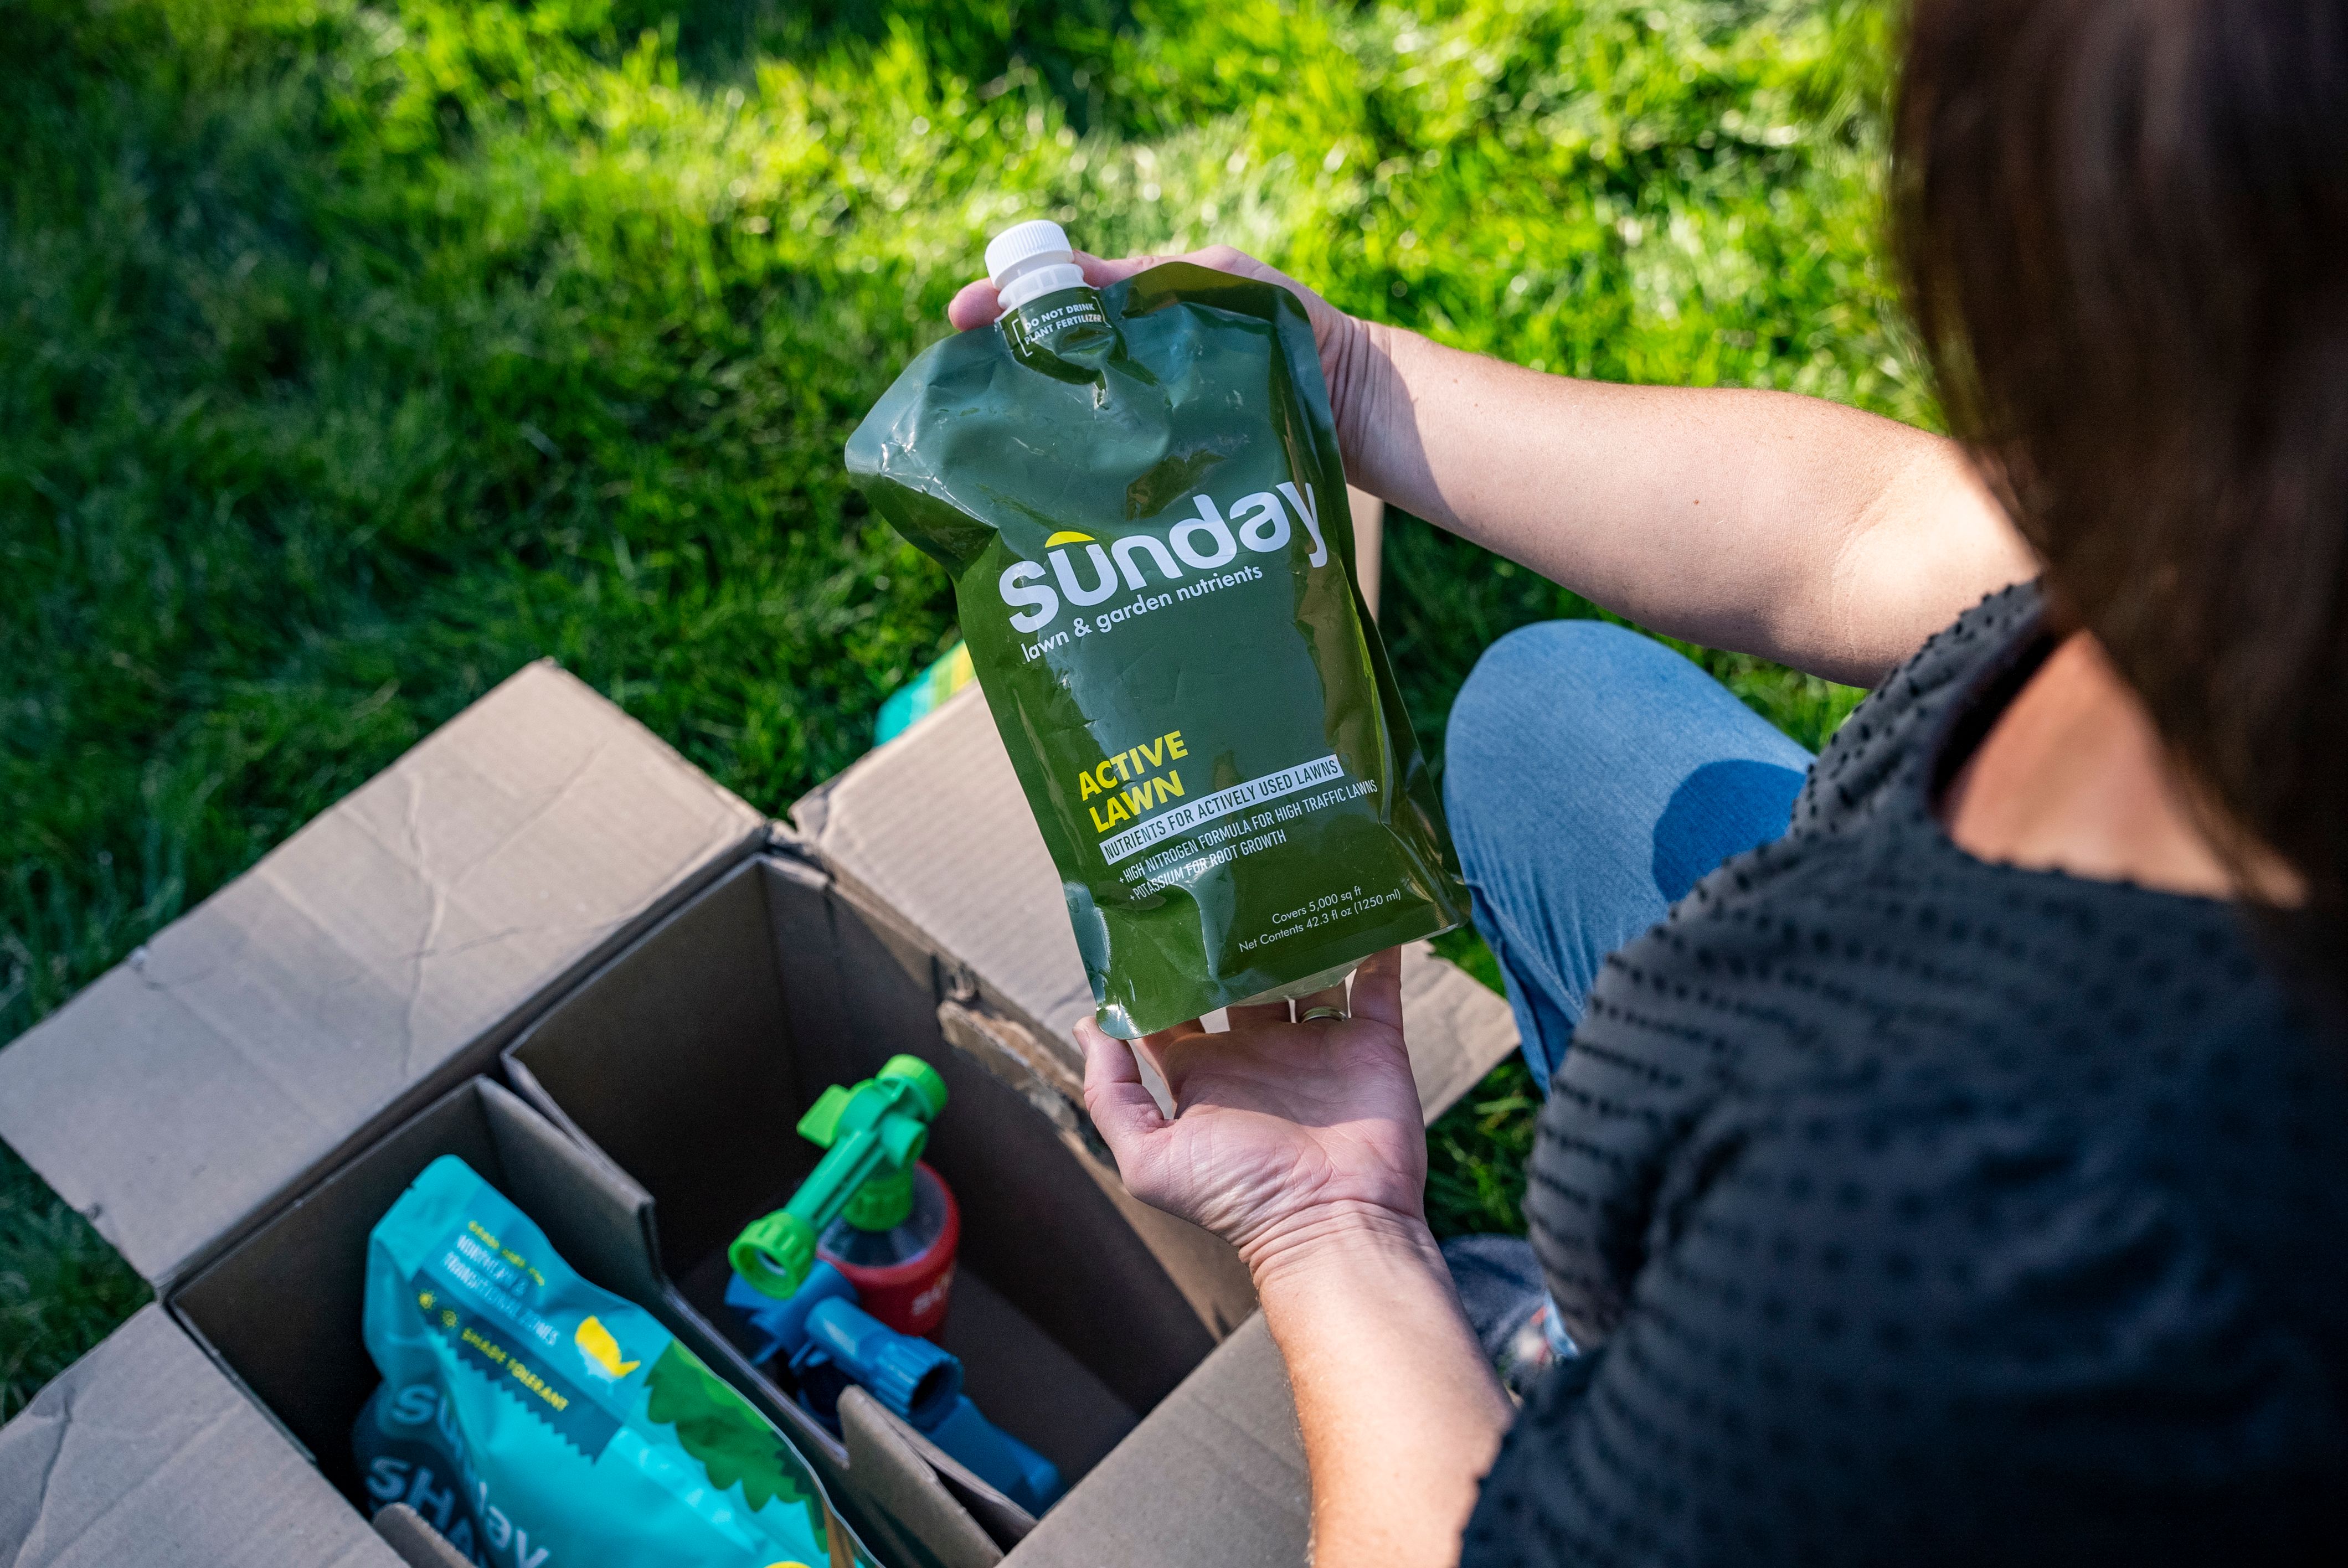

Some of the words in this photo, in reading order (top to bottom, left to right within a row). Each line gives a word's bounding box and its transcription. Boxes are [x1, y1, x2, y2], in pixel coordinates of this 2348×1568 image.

[1024, 318, 1039, 331] DO
[1041, 308, 1063, 322] NOT
[1065, 303, 1095, 314] DRINK
[1024, 324, 1053, 345] PLANT
[1055, 314, 1102, 329] FERTILIZER
[999, 481, 1328, 633] sunday
[1021, 630, 1070, 663] lawn
[1073, 617, 1093, 637] &
[1096, 593, 1173, 633] garden
[1176, 565, 1263, 601] nutrients
[1079, 730, 1188, 801] ACTIVE
[1089, 770, 1185, 833] LAWN
[1104, 821, 1166, 860] NUTRIENTS
[1167, 809, 1194, 831] FOR
[1197, 785, 1256, 819] ACTIVELY
[1259, 773, 1293, 797] USED
[1295, 759, 1338, 785] LAWNS
[1123, 863, 1146, 883] HIGH
[1145, 839, 1199, 873] NITROGEN
[1198, 819, 1252, 850] FORMULA
[1251, 812, 1275, 830] FOR
[1274, 802, 1302, 822] HIGH
[1301, 788, 1346, 813] TRAFFIC
[1345, 779, 1377, 799] LAWNS
[1132, 866, 1185, 900] POTASSIUM
[1186, 858, 1208, 876] FOR
[1209, 844, 1238, 866] ROOT
[1240, 829, 1287, 856] GROWTH
[1239, 939, 1258, 952] Net
[1260, 924, 1304, 945] Contents
[1306, 914, 1329, 929] 42.3
[1331, 910, 1338, 920] fl
[1341, 907, 1352, 917] oz
[1354, 895, 1383, 914] (1250
[1386, 888, 1401, 902] ml)
[1272, 907, 1307, 924] Covers
[1309, 894, 1338, 912] 5,000
[1341, 891, 1353, 901] sq
[1353, 885, 1362, 896] ft
